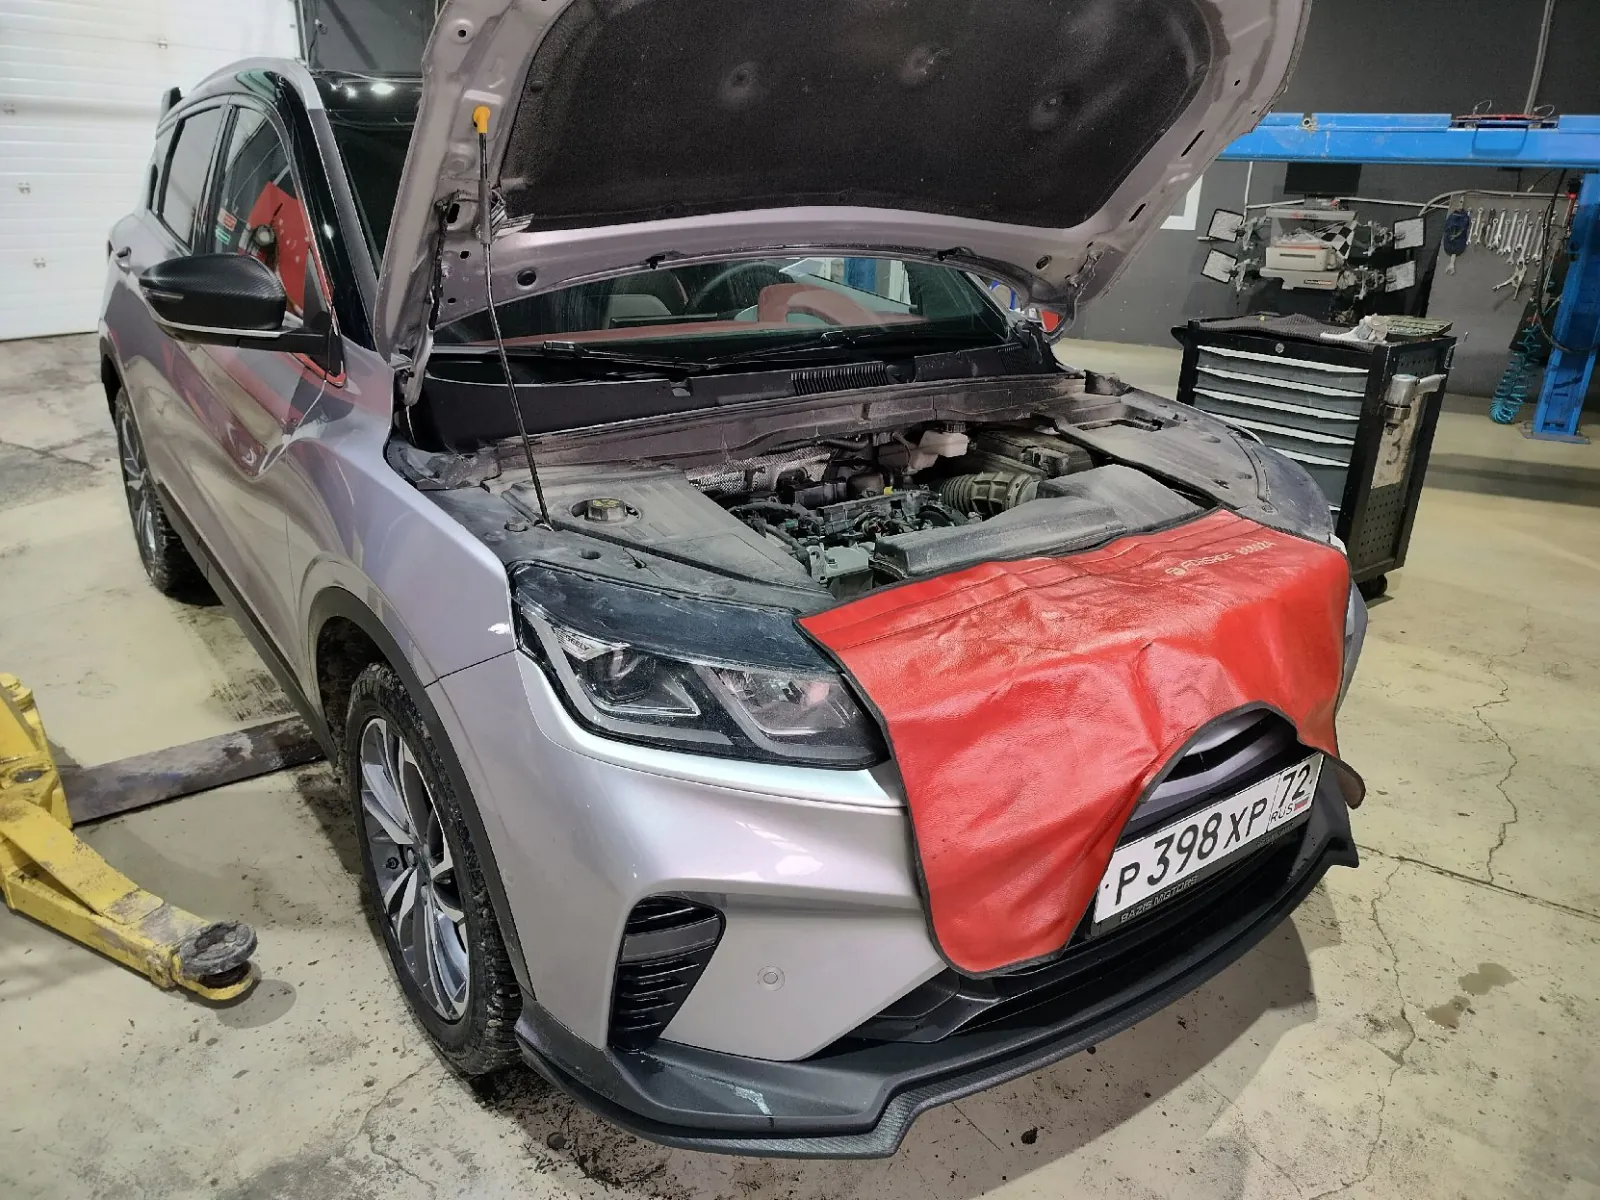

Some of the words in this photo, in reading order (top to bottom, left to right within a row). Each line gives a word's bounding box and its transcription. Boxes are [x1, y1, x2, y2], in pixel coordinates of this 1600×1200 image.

[1279, 764, 1311, 809] 72
[1270, 803, 1294, 824] RUS
[1120, 901, 1153, 924] BAZIS
[1153, 875, 1198, 906] MOTORS
